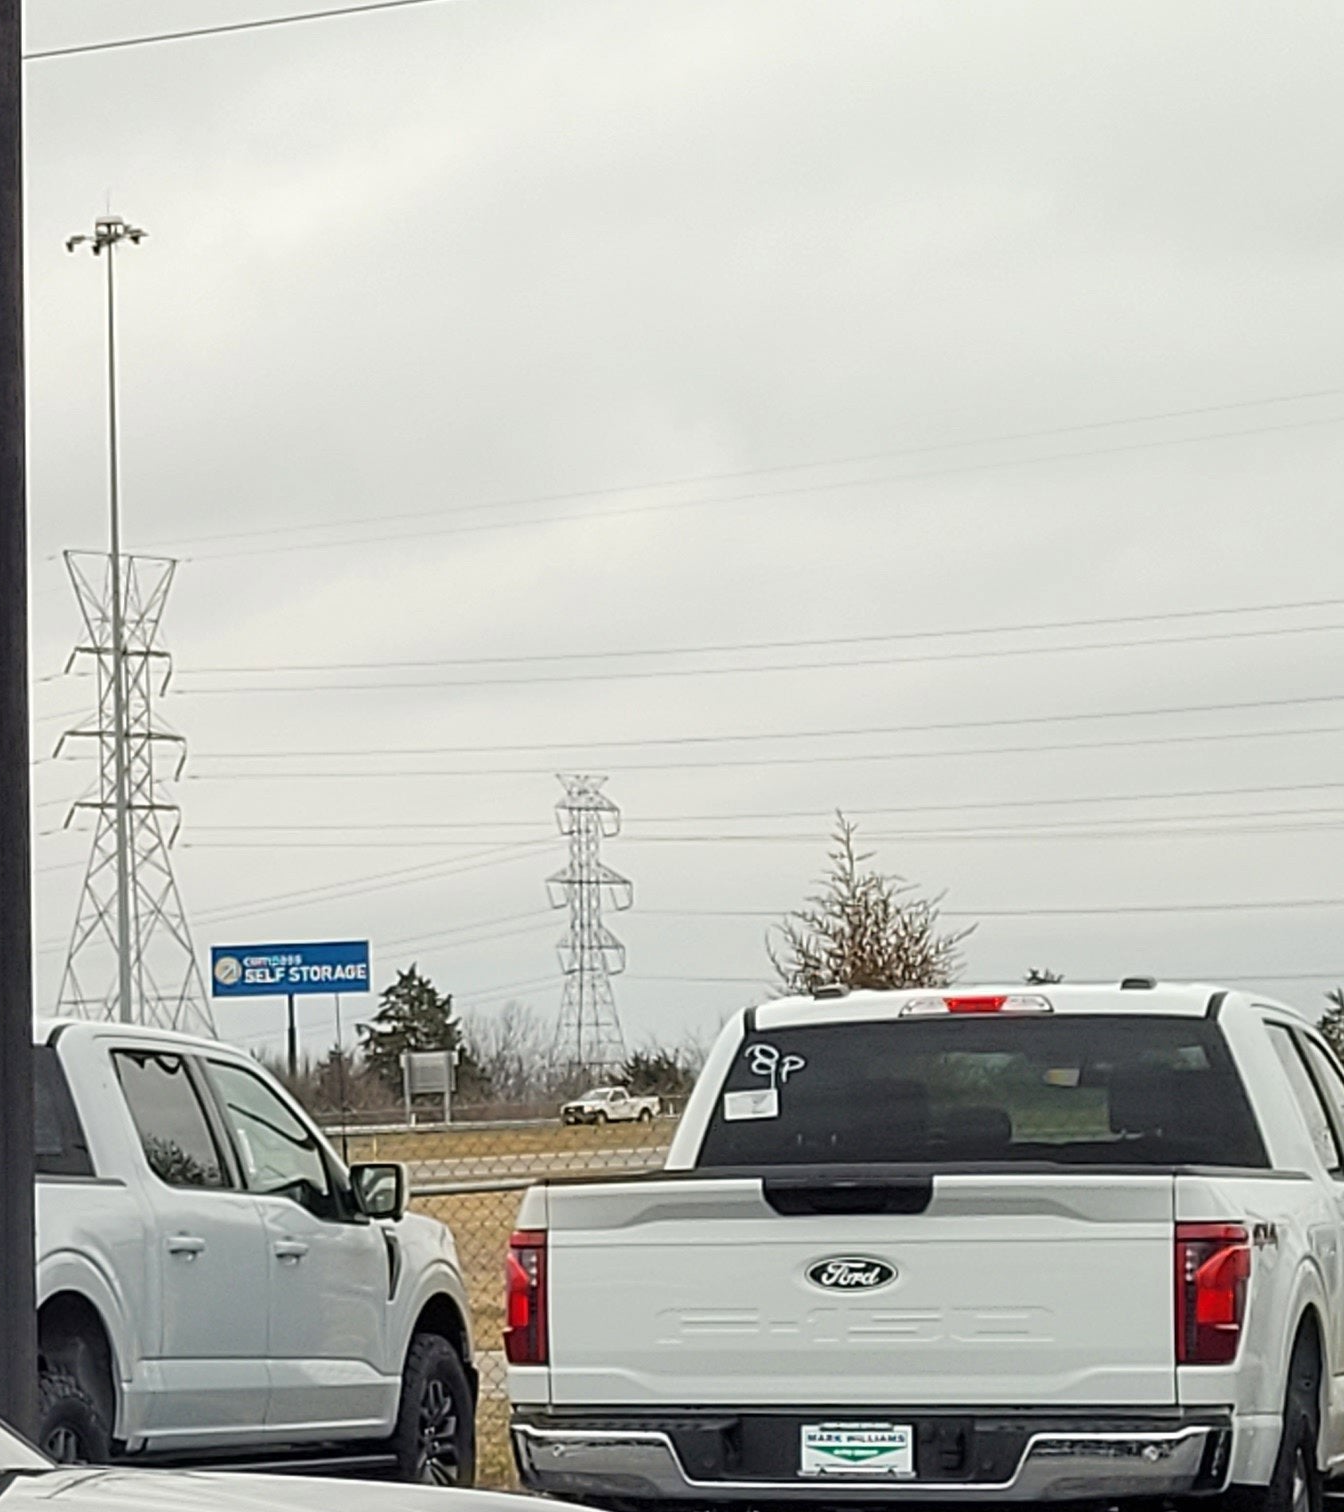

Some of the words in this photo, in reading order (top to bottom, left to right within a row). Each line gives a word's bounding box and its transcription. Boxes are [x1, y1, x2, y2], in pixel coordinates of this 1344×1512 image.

[244, 967, 286, 983] SELF
[288, 964, 367, 982] STORAGE
[819, 1260, 882, 1288] Ford
[807, 1433, 842, 1443] MARK
